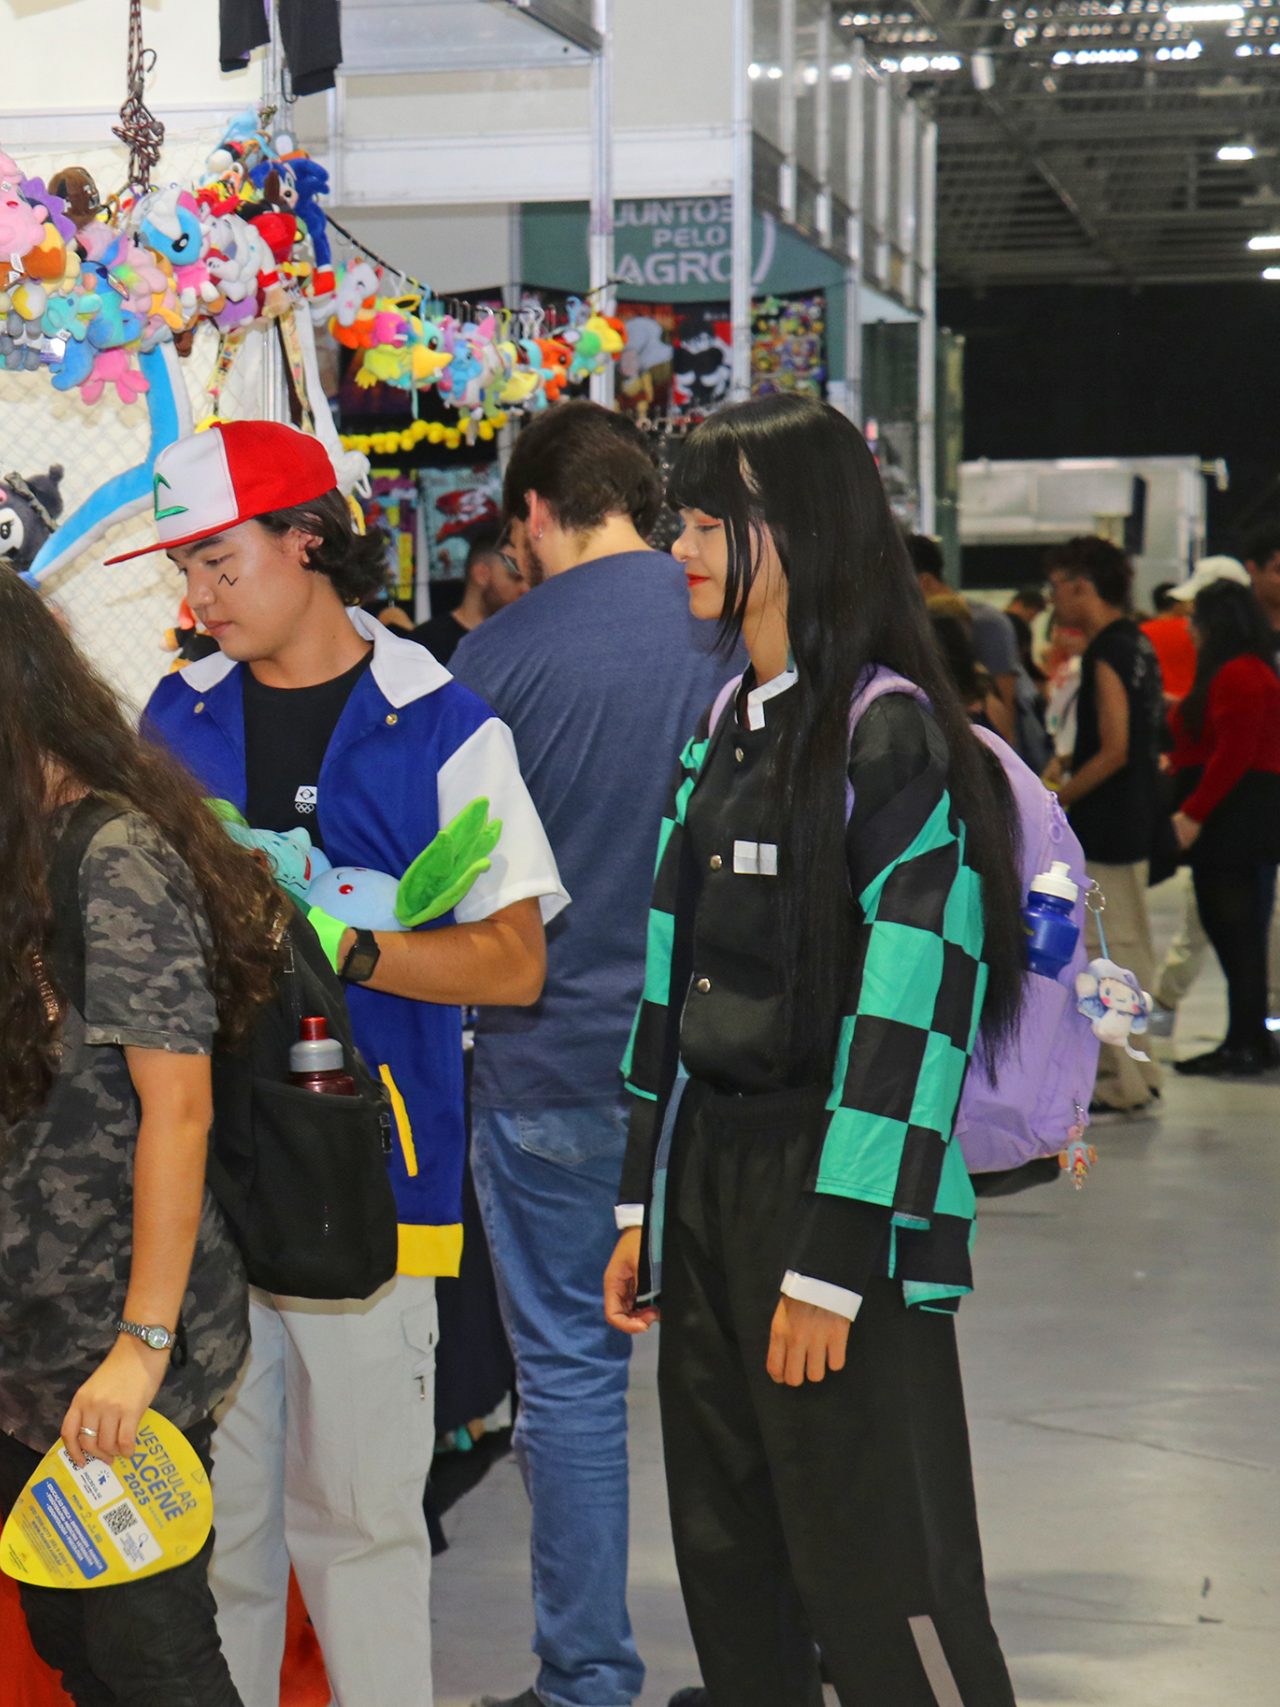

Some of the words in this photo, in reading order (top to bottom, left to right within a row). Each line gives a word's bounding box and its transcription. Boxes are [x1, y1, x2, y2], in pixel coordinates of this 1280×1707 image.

[652, 226, 727, 249] PELO
[614, 251, 733, 286] AGRO
[139, 1425, 197, 1512] VESTIBULAR
[123, 1472, 151, 1506] 2025
